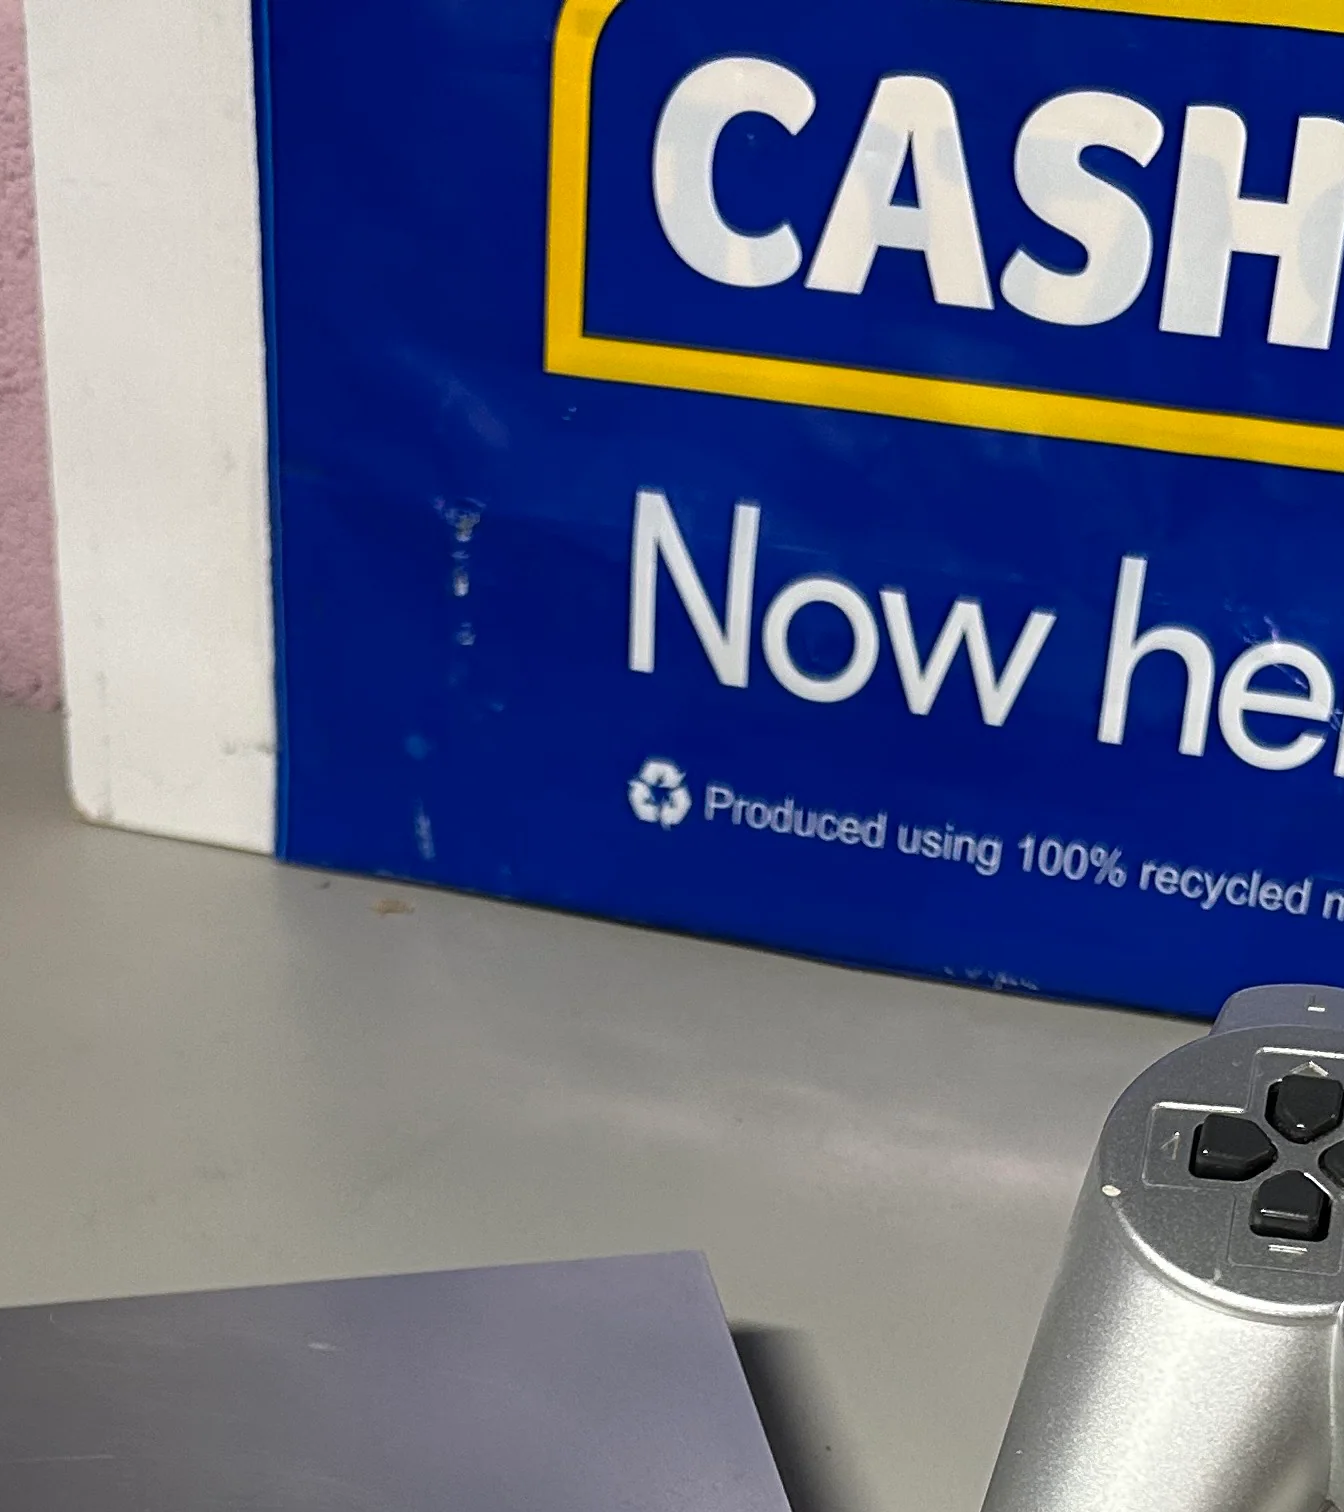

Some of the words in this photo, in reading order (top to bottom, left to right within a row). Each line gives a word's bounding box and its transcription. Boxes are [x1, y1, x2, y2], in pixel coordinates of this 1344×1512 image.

[628, 488, 1056, 728] Now
[703, 783, 887, 849] Produced
[897, 822, 1003, 876] using
[1018, 832, 1127, 888] 100%
[1139, 859, 1312, 914] recycled
